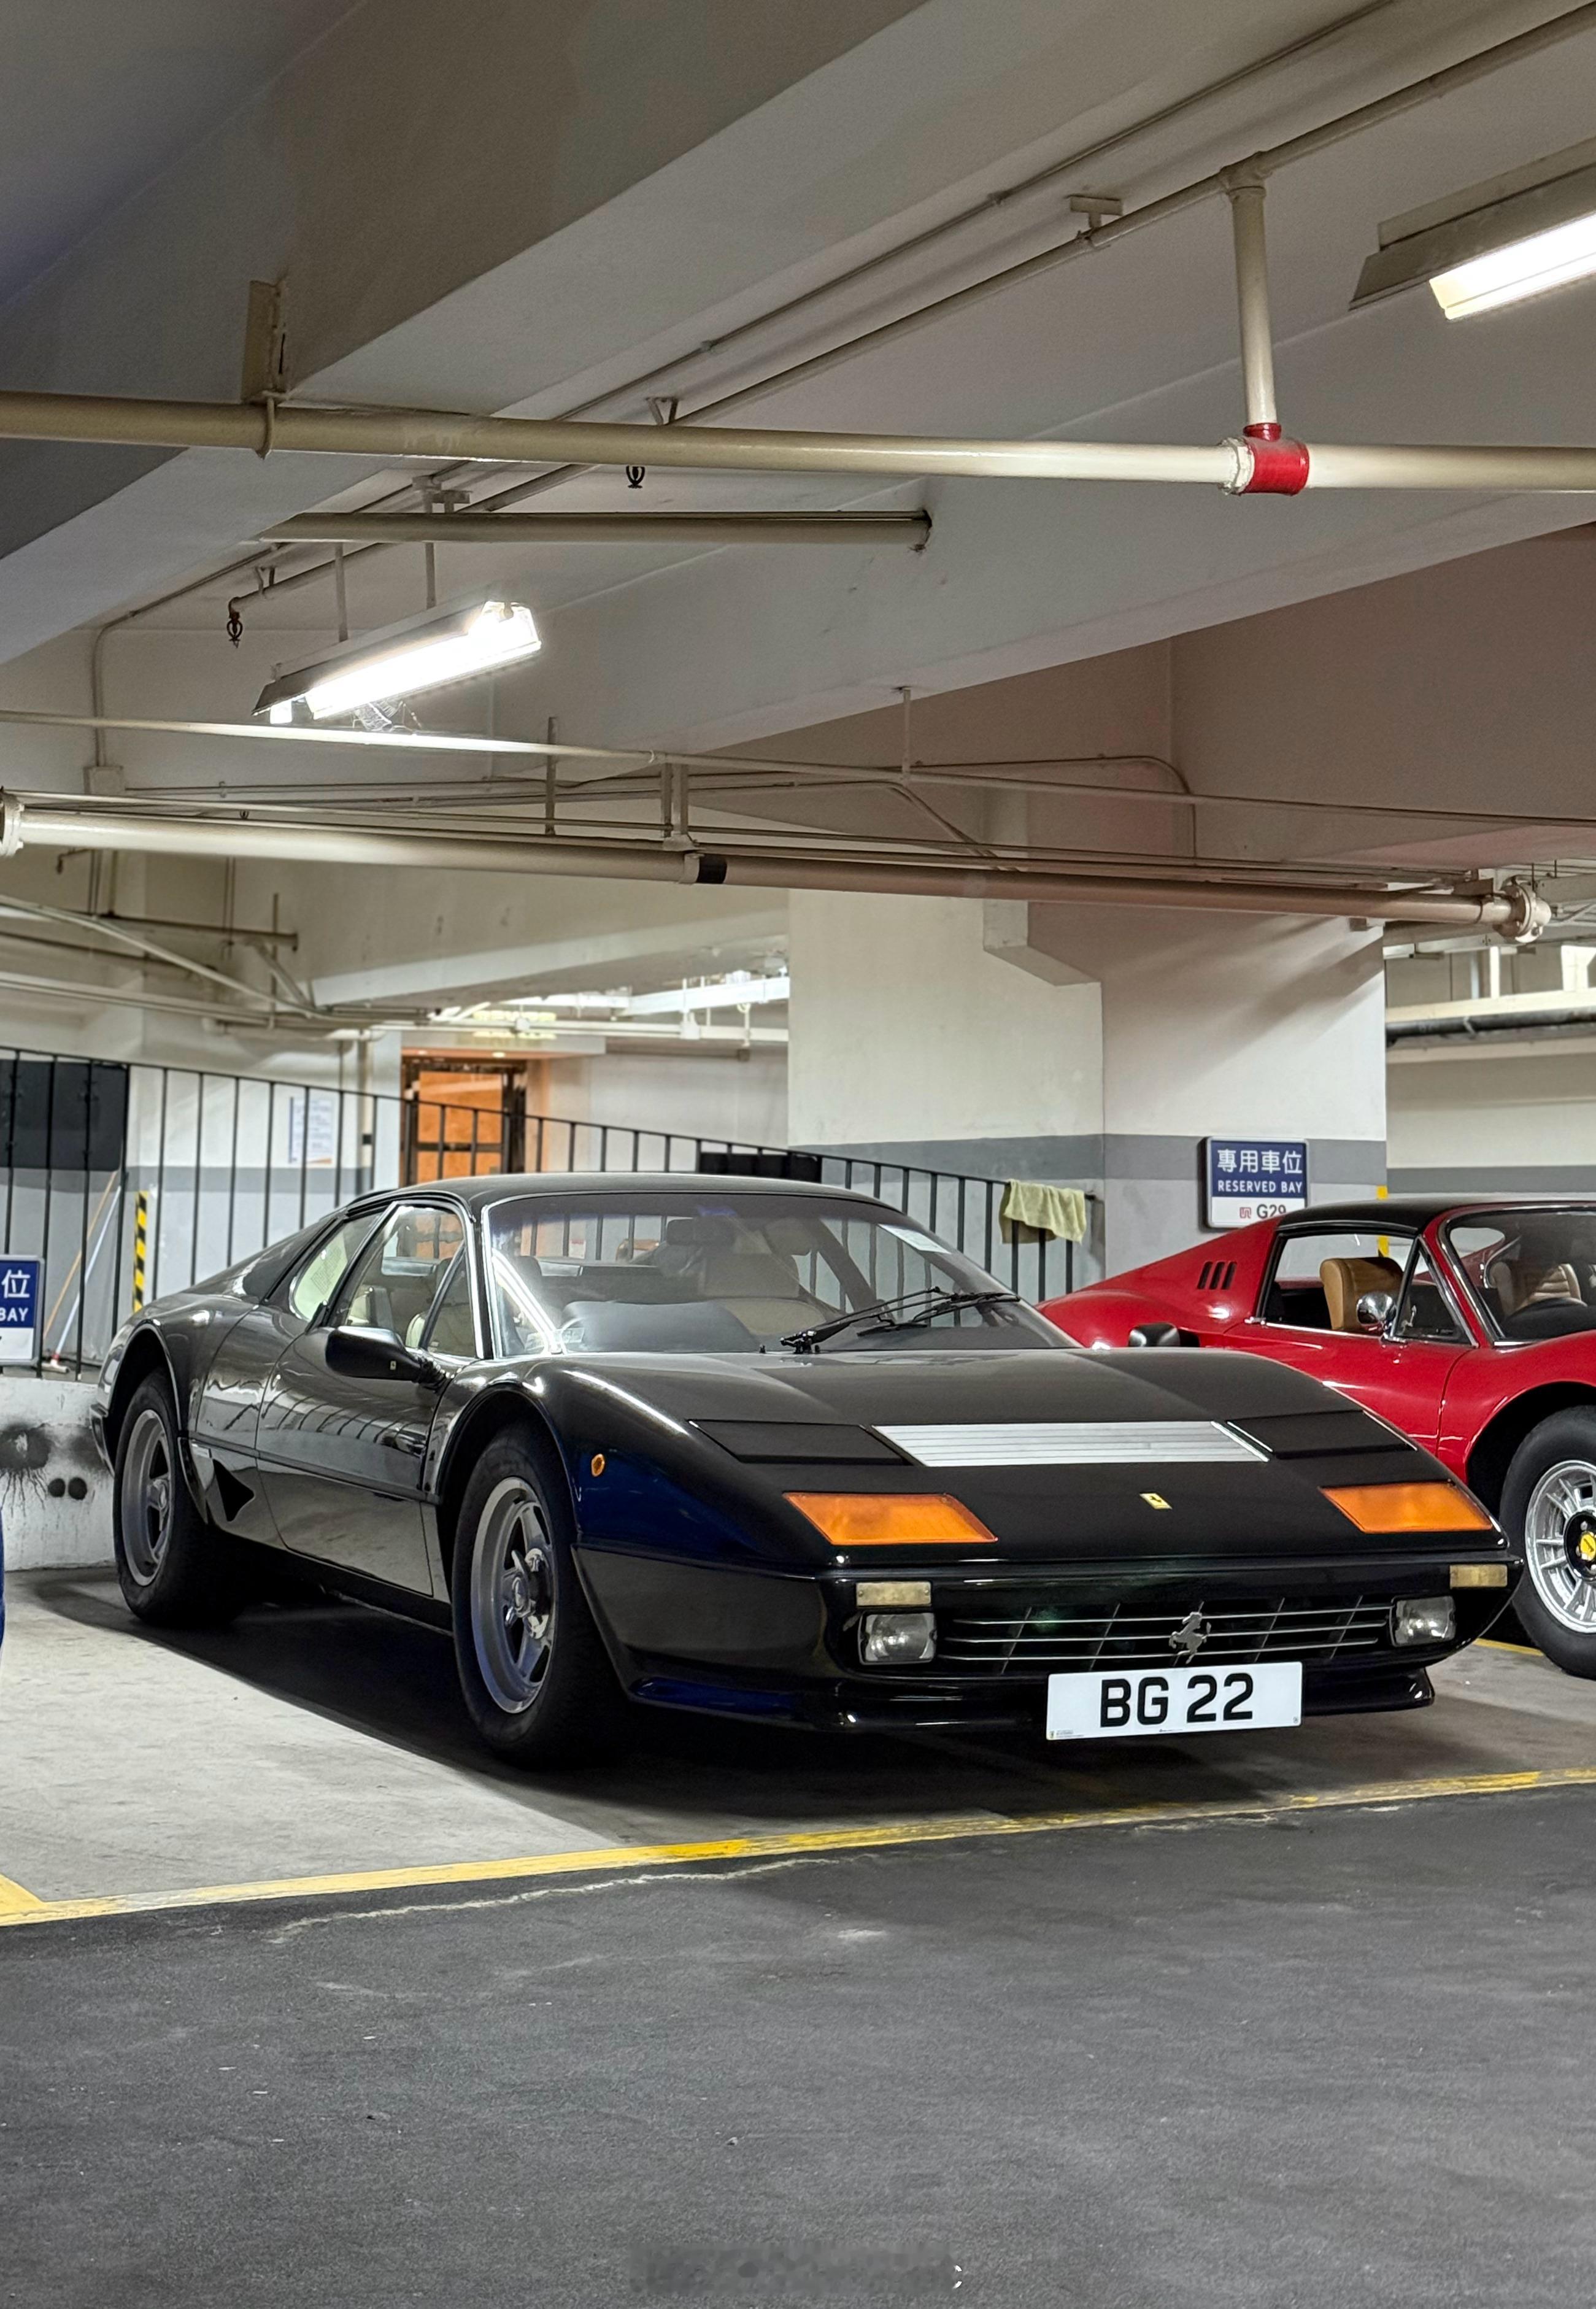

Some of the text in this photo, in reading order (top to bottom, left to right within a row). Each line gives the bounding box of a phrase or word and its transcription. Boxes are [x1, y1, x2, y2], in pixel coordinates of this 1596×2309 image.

[1217, 1149, 1303, 1174] 專用車位
[1217, 1179, 1302, 1193] RESERVED BAY
[1256, 1203, 1287, 1219] G29
[1, 1269, 30, 1298] 位
[1100, 1673, 1253, 1727] BG 22
